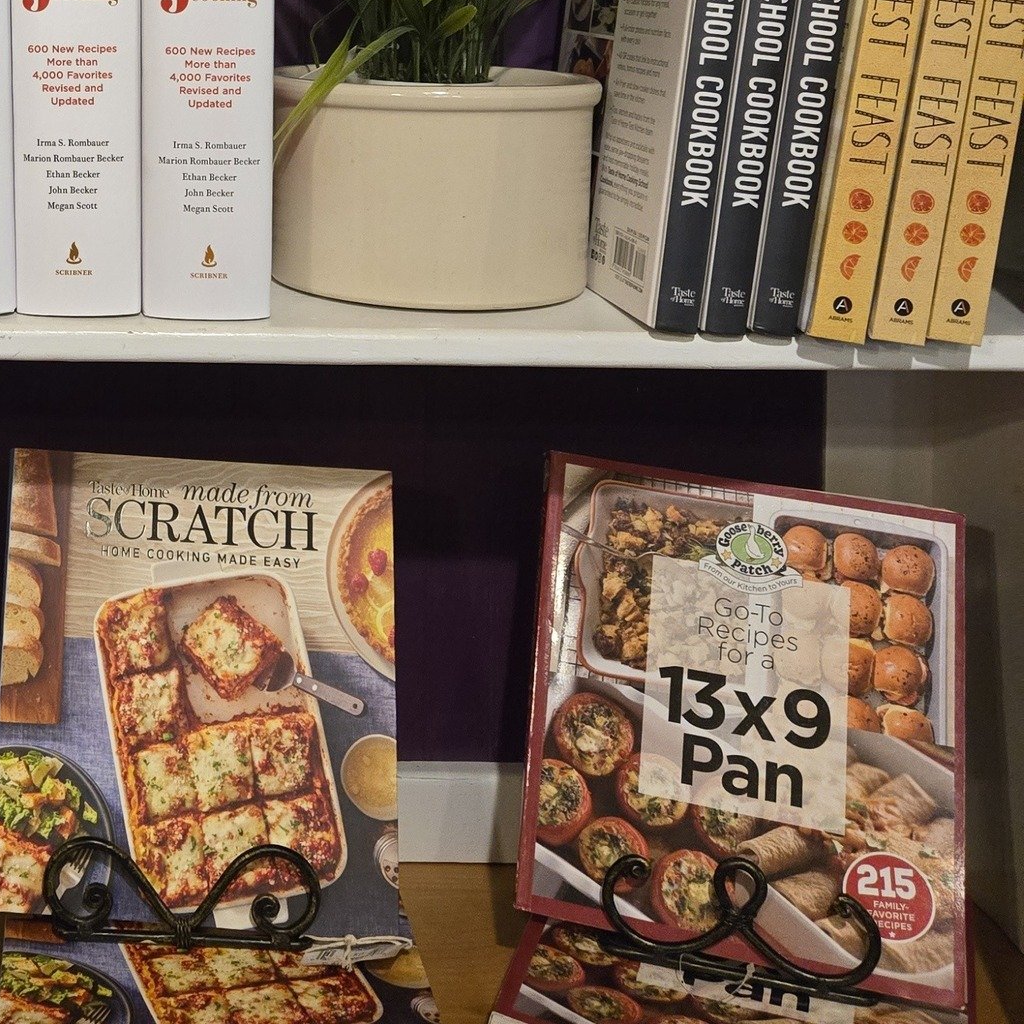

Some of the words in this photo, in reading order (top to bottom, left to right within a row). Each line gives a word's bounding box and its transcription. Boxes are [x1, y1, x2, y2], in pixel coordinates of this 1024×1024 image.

[27, 44, 50, 54] 600
[51, 44, 75, 54] New
[77, 44, 118, 56] Recipes
[46, 57, 73, 68] More
[75, 57, 98, 67] than
[32, 70, 64, 82] 4,000
[66, 70, 113, 80] Favorites
[41, 83, 80, 94] Revised
[82, 83, 104, 93] and
[50, 96, 95, 108] Updated
[849, 73, 901, 175] FEAST
[680, 76, 725, 208] COOKBOOK
[46, 170, 71, 179] Ethan
[72, 170, 101, 179] Becker
[47, 201, 72, 213] Megan
[73, 201, 98, 211] Scott
[55, 268, 93, 276] SCRIBNER
[671, 286, 696, 298] Taste
[828, 314, 853, 324] ABRAMS
[87, 480, 123, 496] Taste
[131, 483, 170, 499] Home
[181, 482, 250, 504] made
[249, 484, 314, 510] from
[85, 496, 319, 552] SCRATCH
[756, 523, 786, 559] berry
[100, 545, 140, 559] HOME
[147, 548, 211, 564] COOKING
[217, 553, 257, 566] MADE
[263, 556, 301, 569] EASY
[730, 559, 774, 576] Patch
[736, 579, 769, 593] Kitchen
[775, 577, 798, 589] Yours
[713, 596, 785, 627] Go-To
[697, 615, 799, 653] Recipes
[717, 640, 755, 666] for
[760, 653, 775, 671] a
[658, 665, 832, 751] 13x9
[680, 732, 804, 809] Pan
[856, 863, 917, 900] 215
